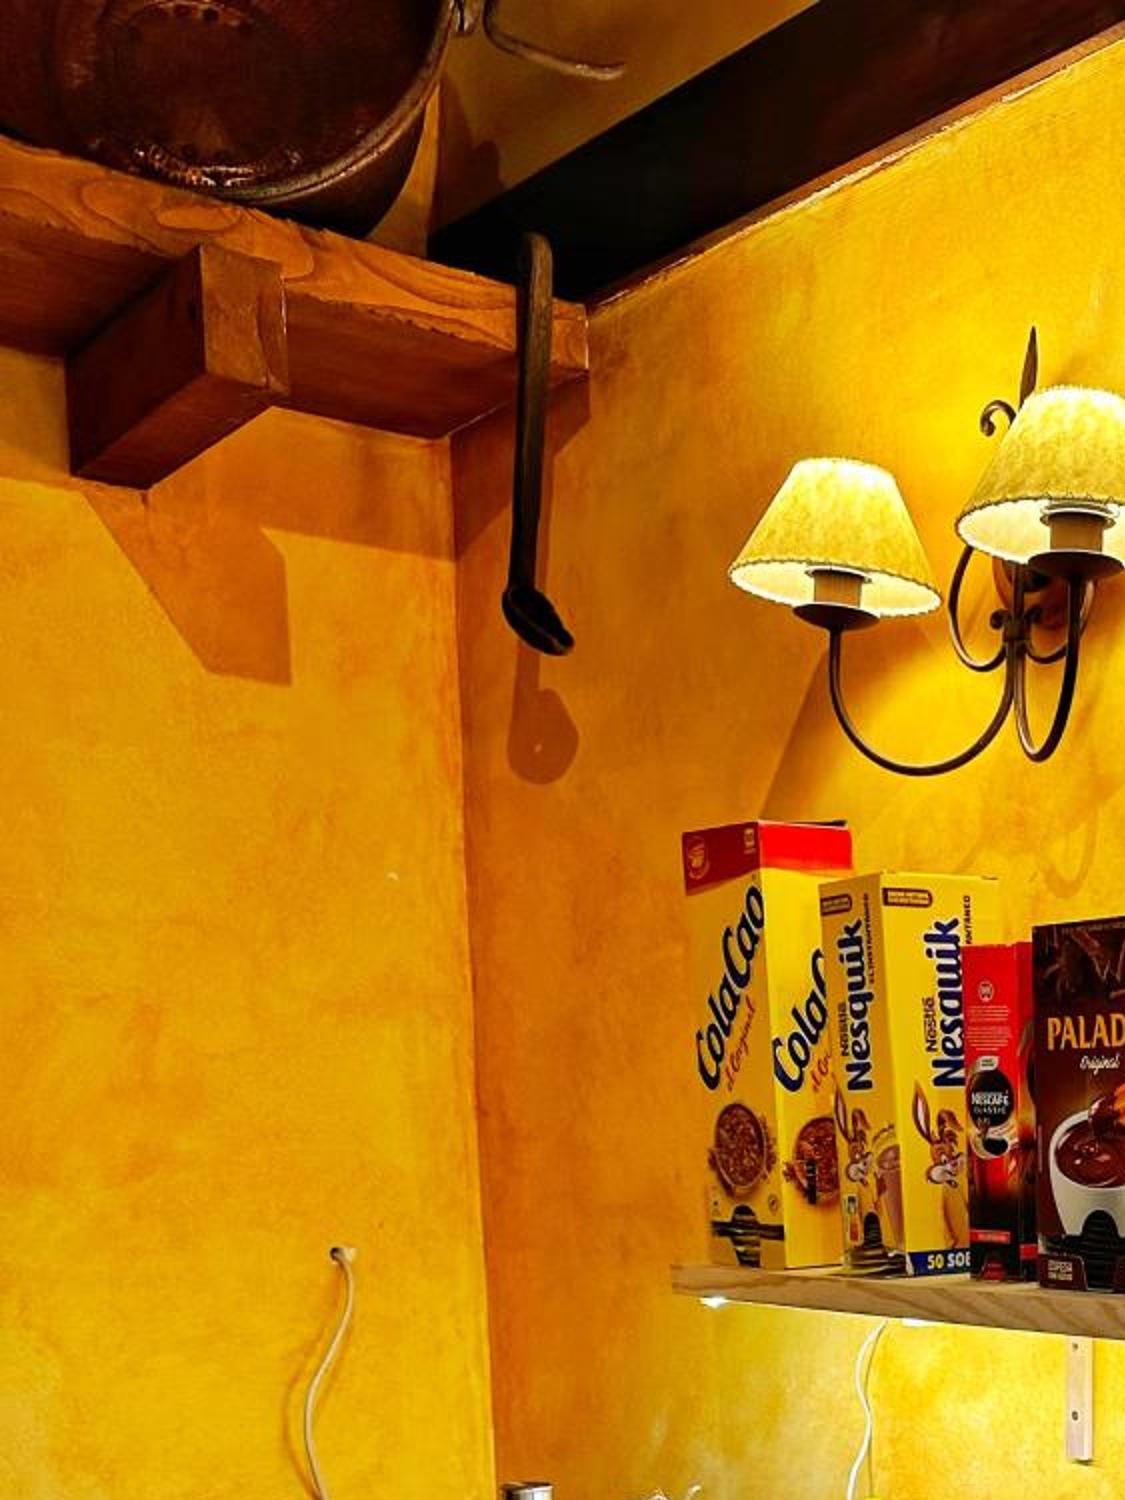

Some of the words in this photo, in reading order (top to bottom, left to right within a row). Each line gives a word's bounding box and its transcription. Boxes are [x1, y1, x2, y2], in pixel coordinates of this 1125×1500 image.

[696, 885, 764, 1091] ColaCao
[836, 918, 875, 1091] Nesquik
[927, 1255, 945, 1270] 50
